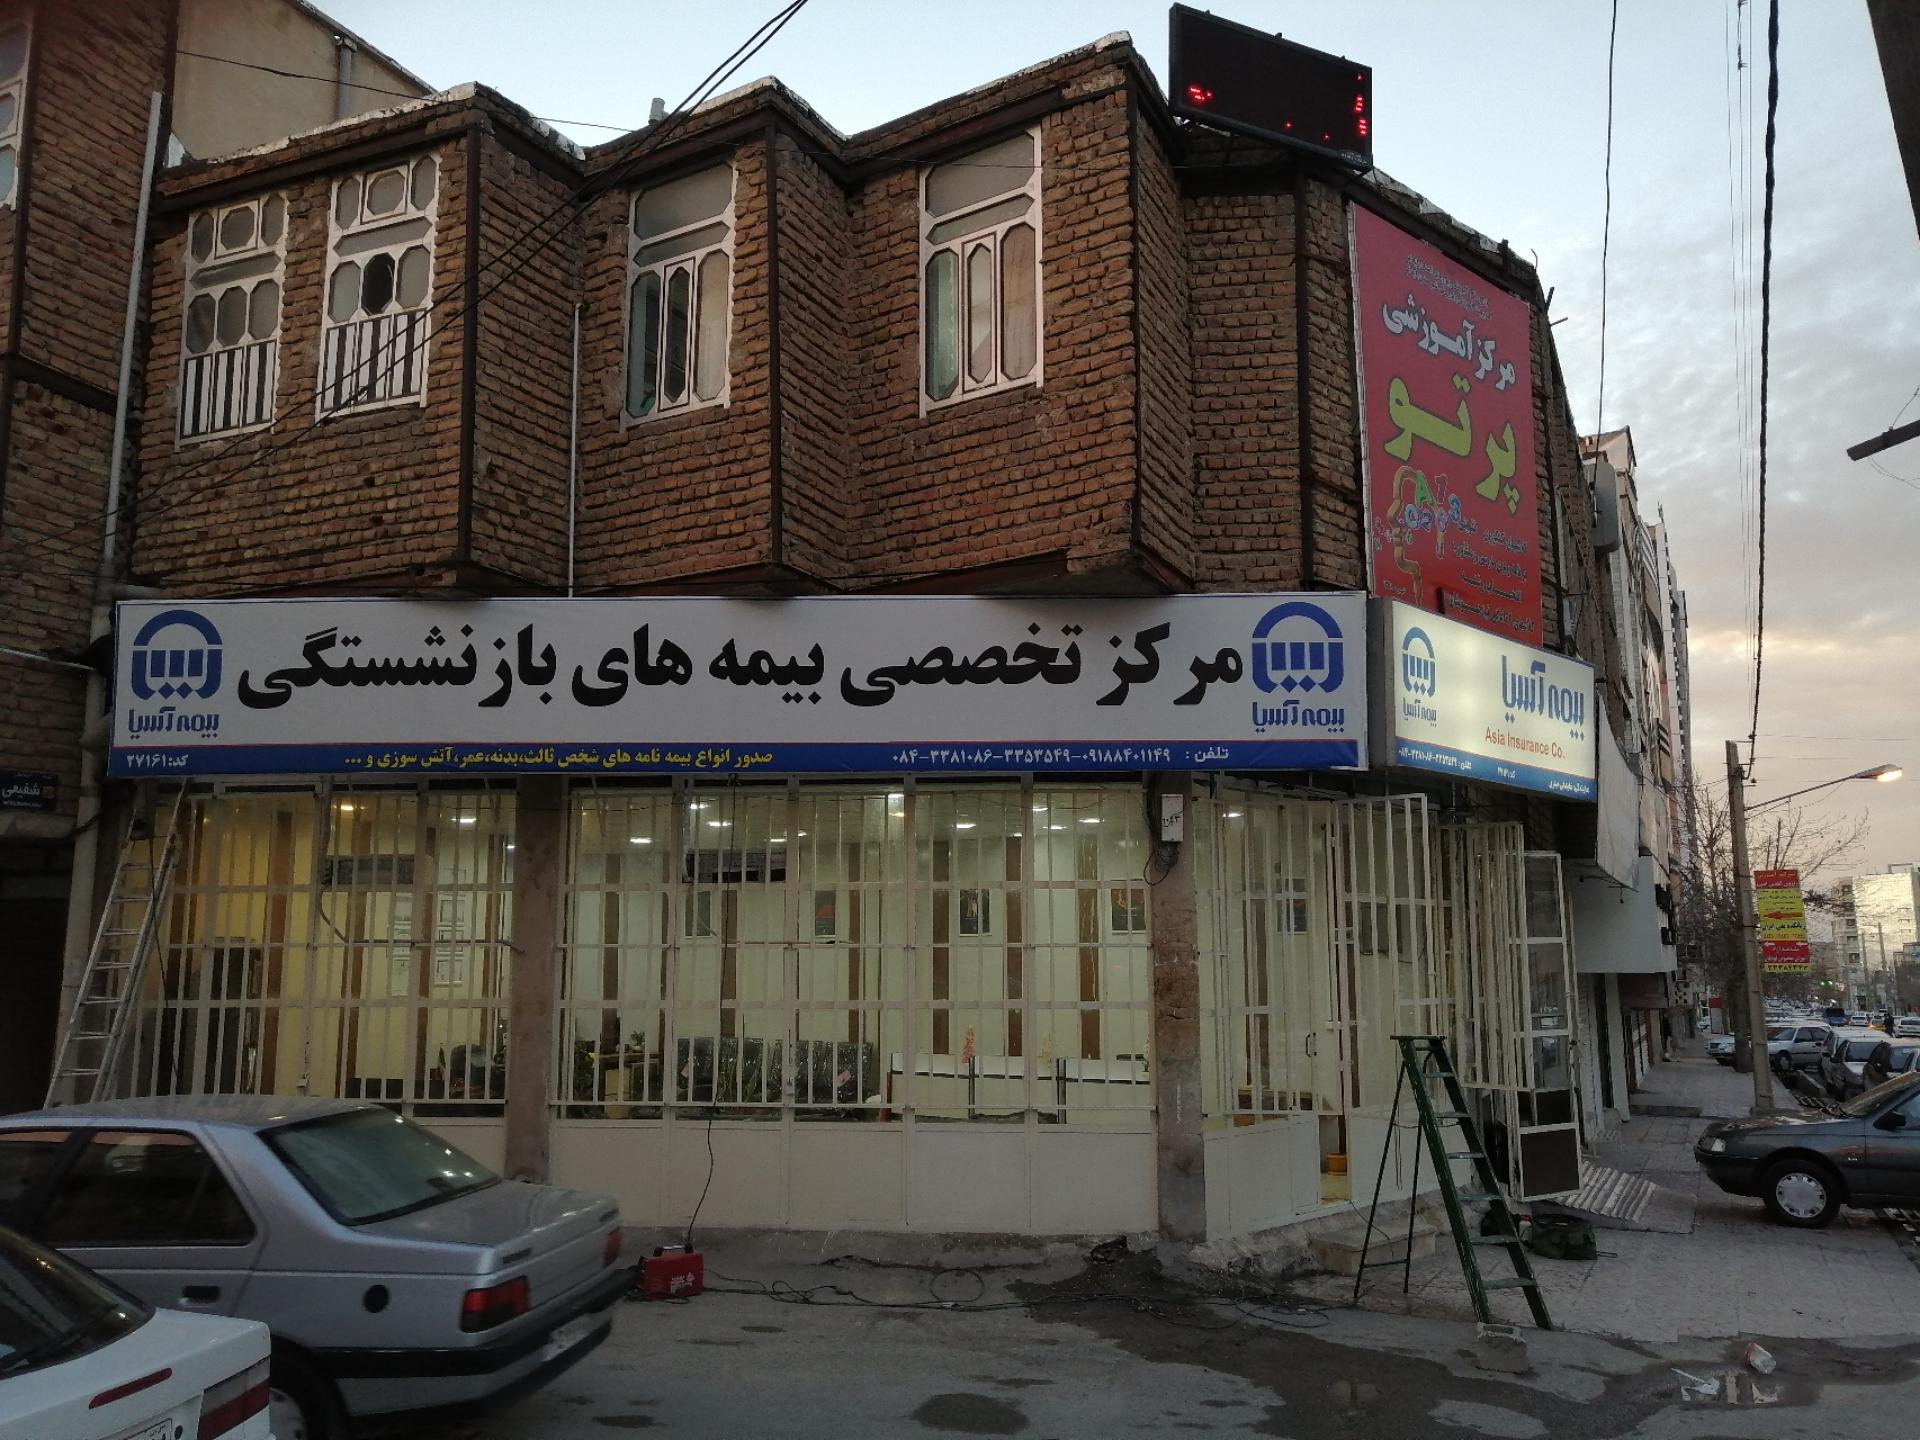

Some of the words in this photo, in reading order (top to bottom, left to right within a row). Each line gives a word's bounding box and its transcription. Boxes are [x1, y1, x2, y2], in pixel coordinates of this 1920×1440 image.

[1382, 293, 1475, 361] آموزشی
[1384, 376, 1520, 515] پرتو
[237, 622, 557, 710] بازنشستگی
[571, 622, 693, 708] های
[708, 637, 825, 705] بیمه
[840, 622, 1082, 707] تخصصی
[1096, 622, 1243, 707] مرکز
[1501, 654, 1546, 724] آسیا
[128, 706, 176, 740] آسیا
[176, 713, 219, 738] بیمه
[1252, 699, 1300, 733] آسیا
[1301, 707, 1344, 733] بیمه
[1548, 684, 1584, 741] بیمه
[421, 747, 453, 768] آتش
[557, 748, 600, 768] شخص
[602, 748, 631, 769] های
[634, 748, 661, 763] نامه
[664, 751, 691, 767] بیمه
[694, 748, 731, 768] انواع
[733, 750, 773, 768] صدور
[1194, 746, 1229, 763] تلفن
[1485, 726, 1506, 746] Asia
[1507, 731, 1549, 756] Insurance
[1551, 742, 1565, 759] Co.
[377, 751, 417, 768] سوزی
